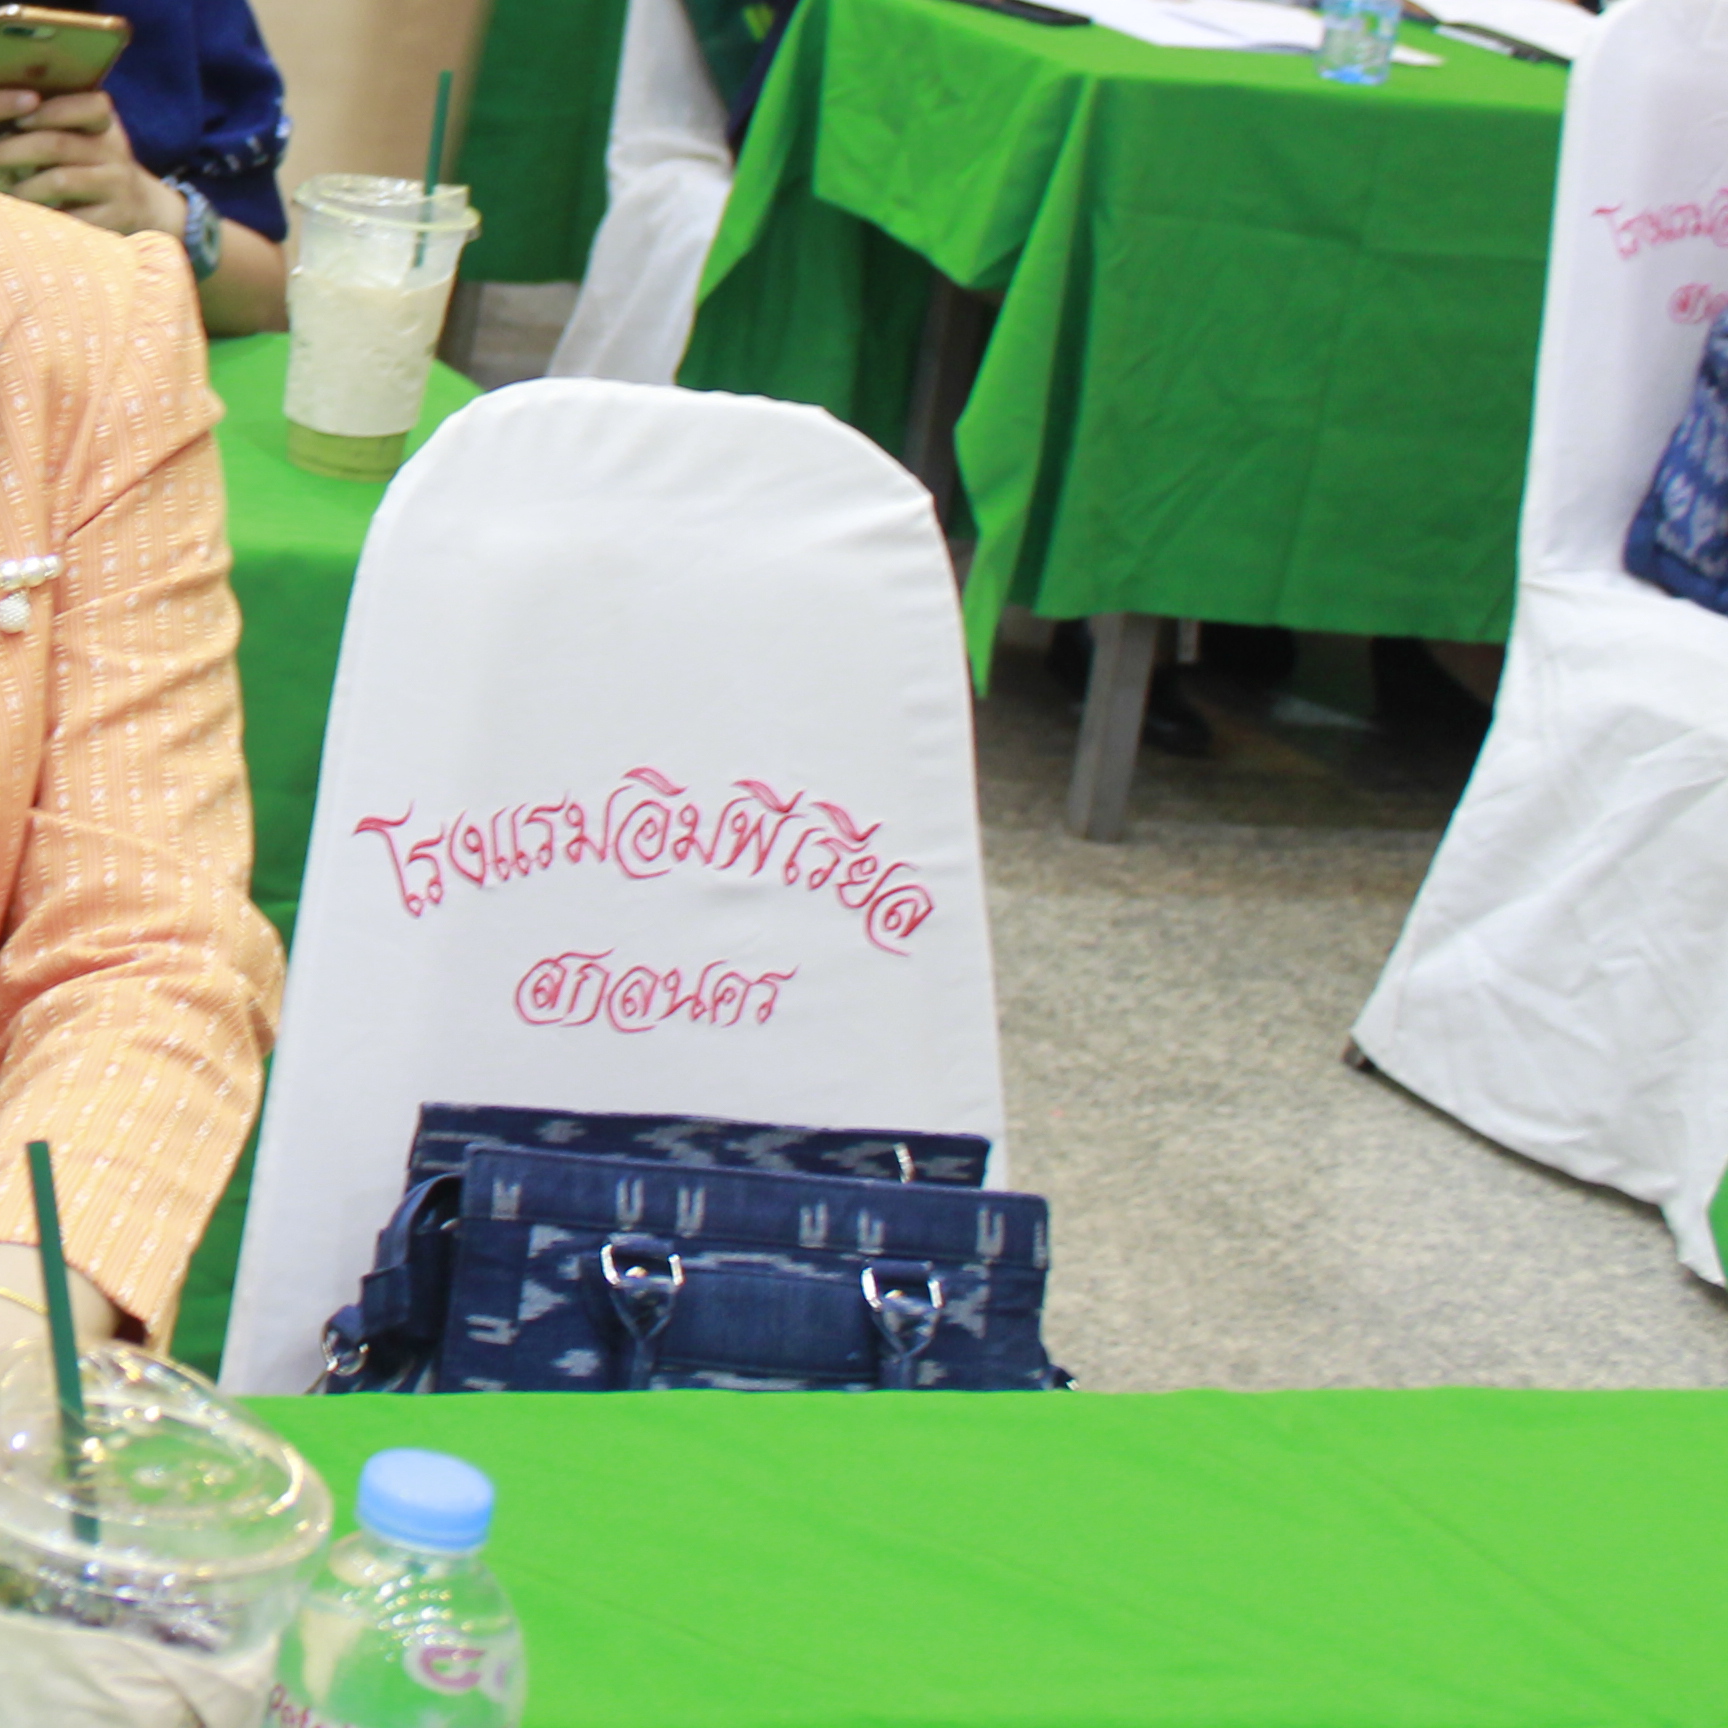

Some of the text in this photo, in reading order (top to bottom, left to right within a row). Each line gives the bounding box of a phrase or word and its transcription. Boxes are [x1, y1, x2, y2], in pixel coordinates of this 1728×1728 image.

[352, 765, 935, 957] โรงแรมอิมพีเรียล
[514, 948, 801, 1034] สกลนคร
